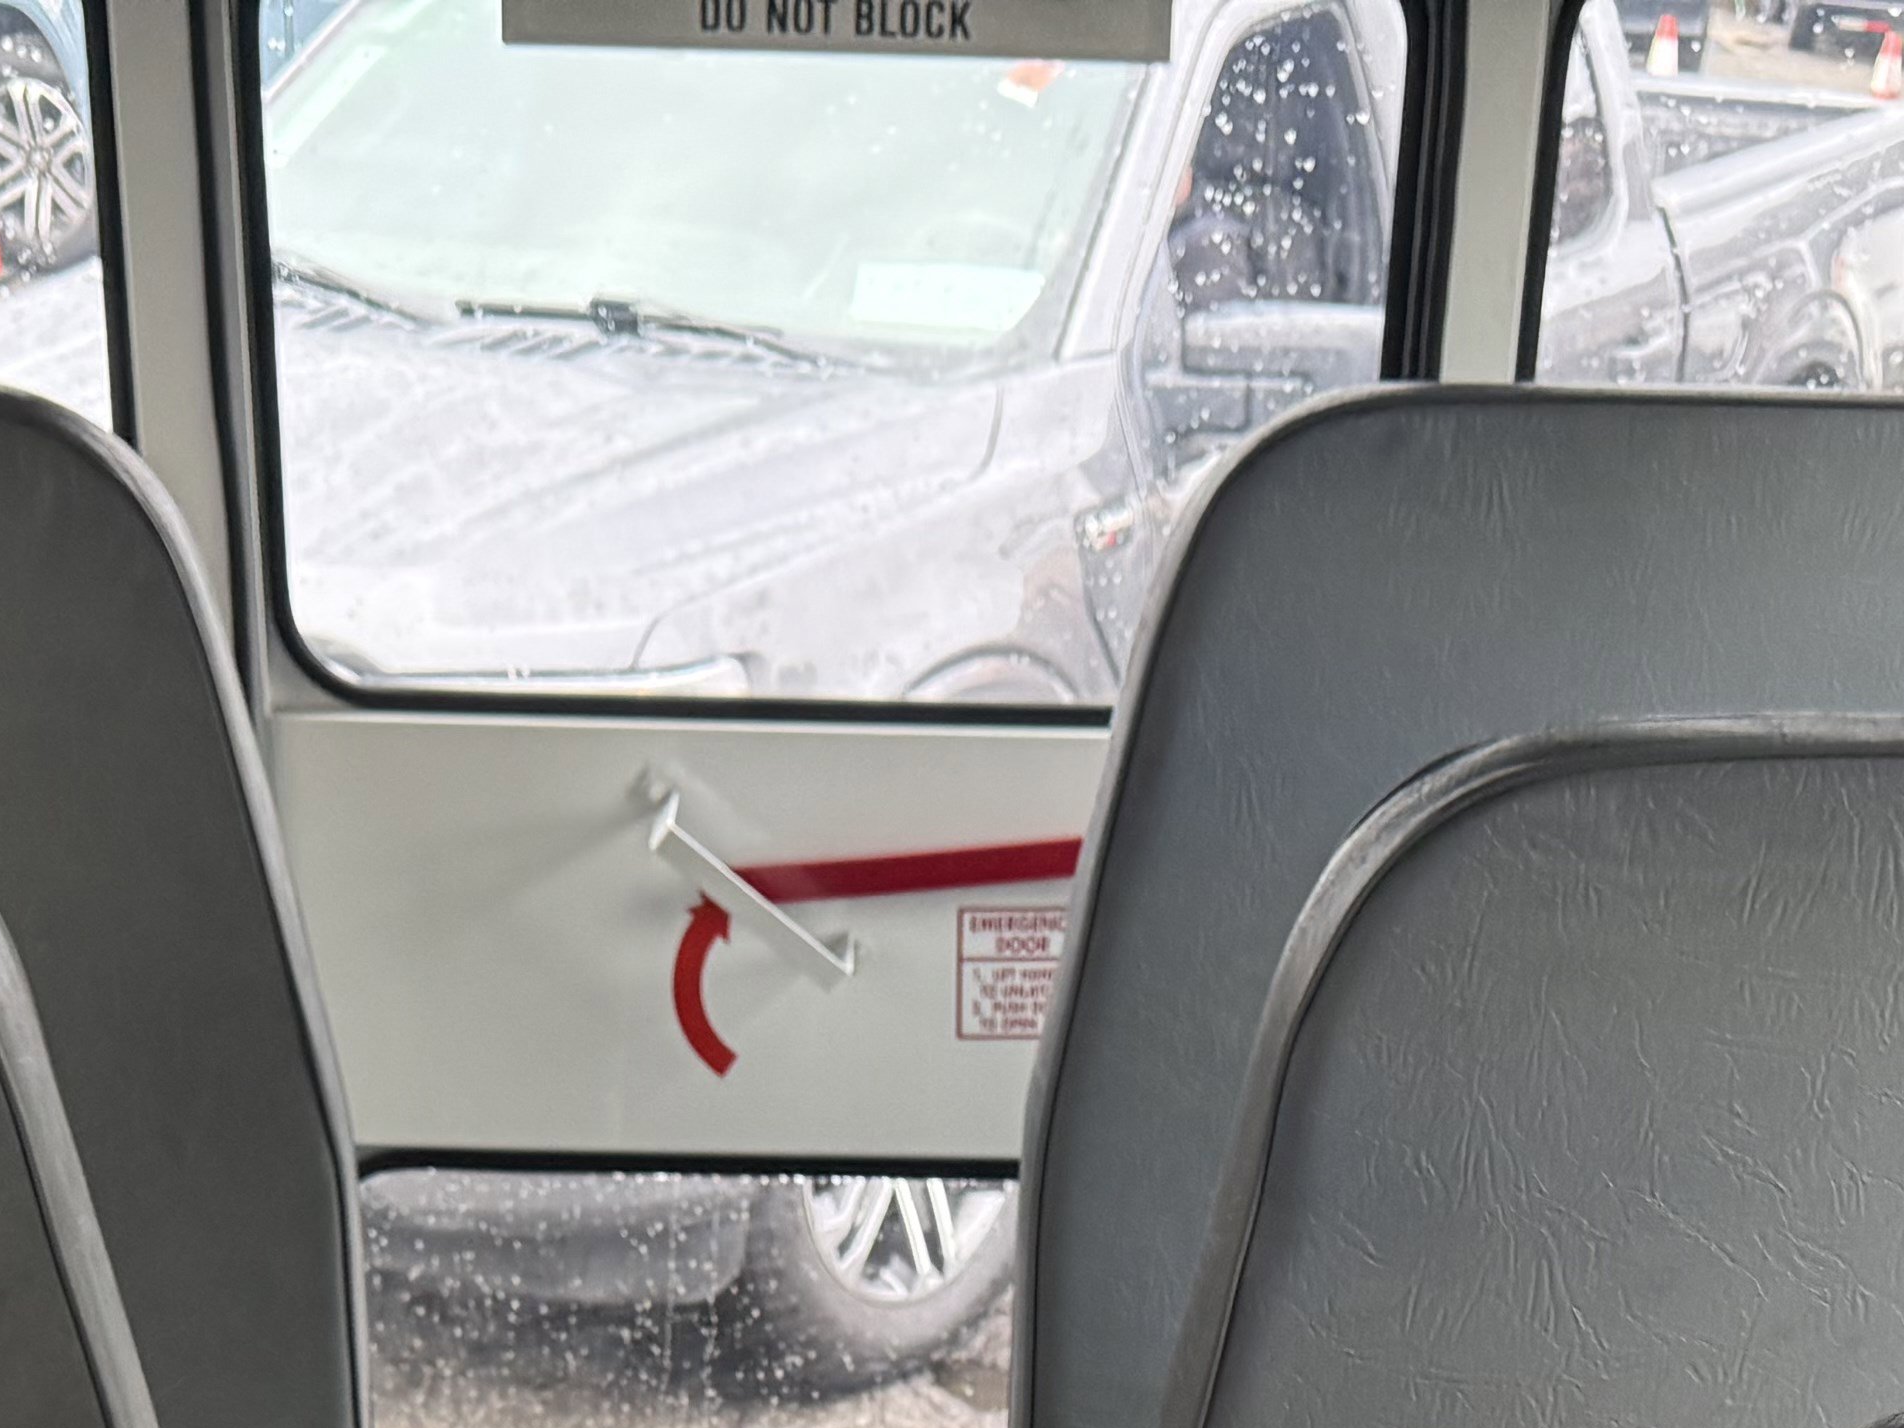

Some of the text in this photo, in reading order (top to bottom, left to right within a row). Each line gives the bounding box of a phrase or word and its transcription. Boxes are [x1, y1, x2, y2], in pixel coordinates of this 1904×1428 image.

[700, 0, 970, 39] DO NOT BLOCK
[969, 915, 1067, 932] EMERGENC
[996, 936, 1050, 953] DOOR
